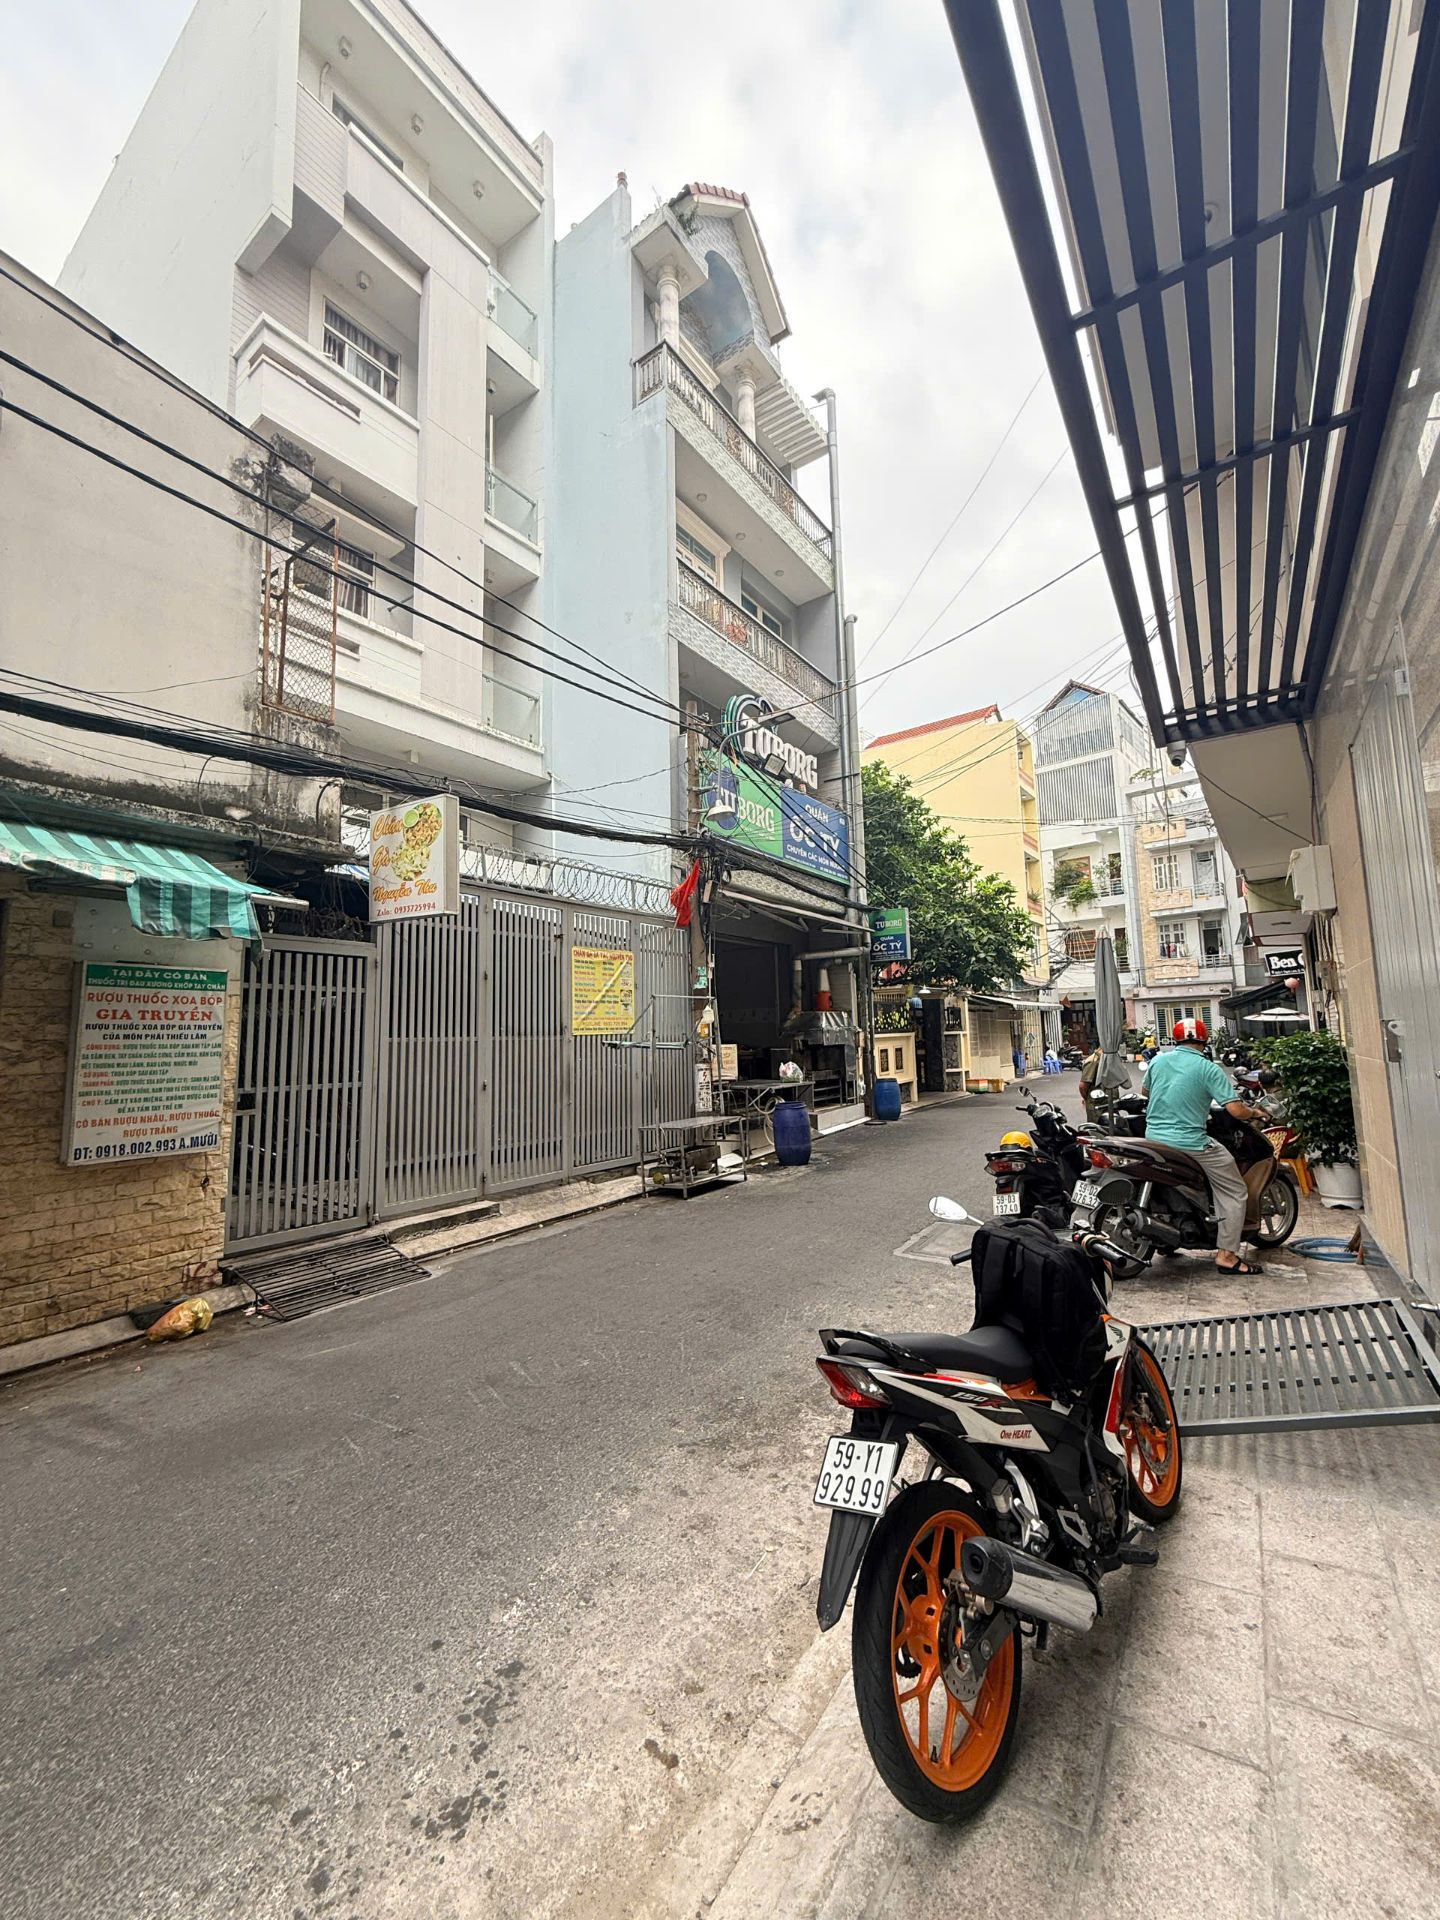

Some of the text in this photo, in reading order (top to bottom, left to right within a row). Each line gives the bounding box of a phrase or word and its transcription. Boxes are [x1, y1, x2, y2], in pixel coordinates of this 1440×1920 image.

[1269, 956, 1298, 969] Ben
[87, 991, 223, 1005] RƯỢU THUỐC XOA BÓP
[96, 1008, 132, 1020] GIA
[112, 1022, 140, 1030] THUỐC
[74, 1146, 93, 1160] ĐT:
[95, 1139, 177, 1158] 0918.002.993
[1000, 1429, 1033, 1439] One HEART
[833, 1441, 884, 1475] 59-Y1
[819, 1471, 885, 1510] 929.99
